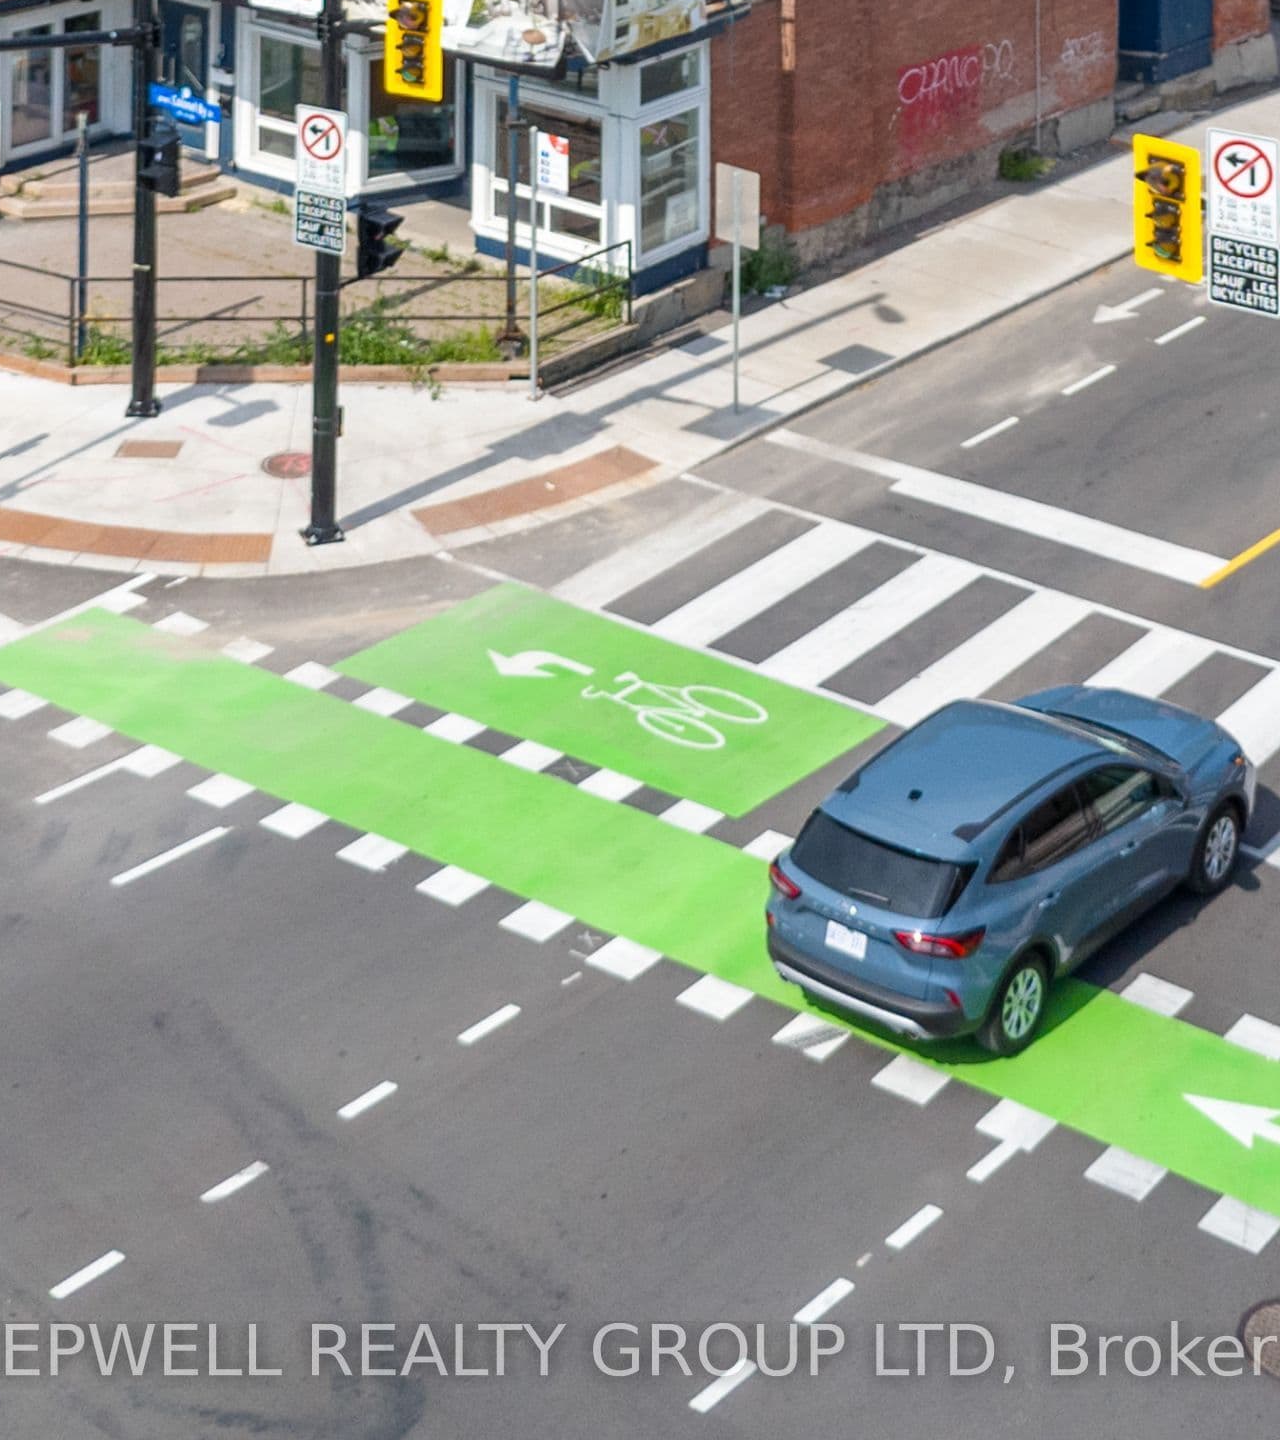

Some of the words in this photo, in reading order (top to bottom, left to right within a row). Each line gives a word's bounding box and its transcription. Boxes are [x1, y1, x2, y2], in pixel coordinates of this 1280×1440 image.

[1213, 237, 1276, 261] BICYCLES
[1213, 253, 1277, 277] EXCEPTED
[1213, 270, 1247, 291] SAUF
[1252, 279, 1277, 297] LES
[1212, 287, 1277, 313] BICYCLETTES
